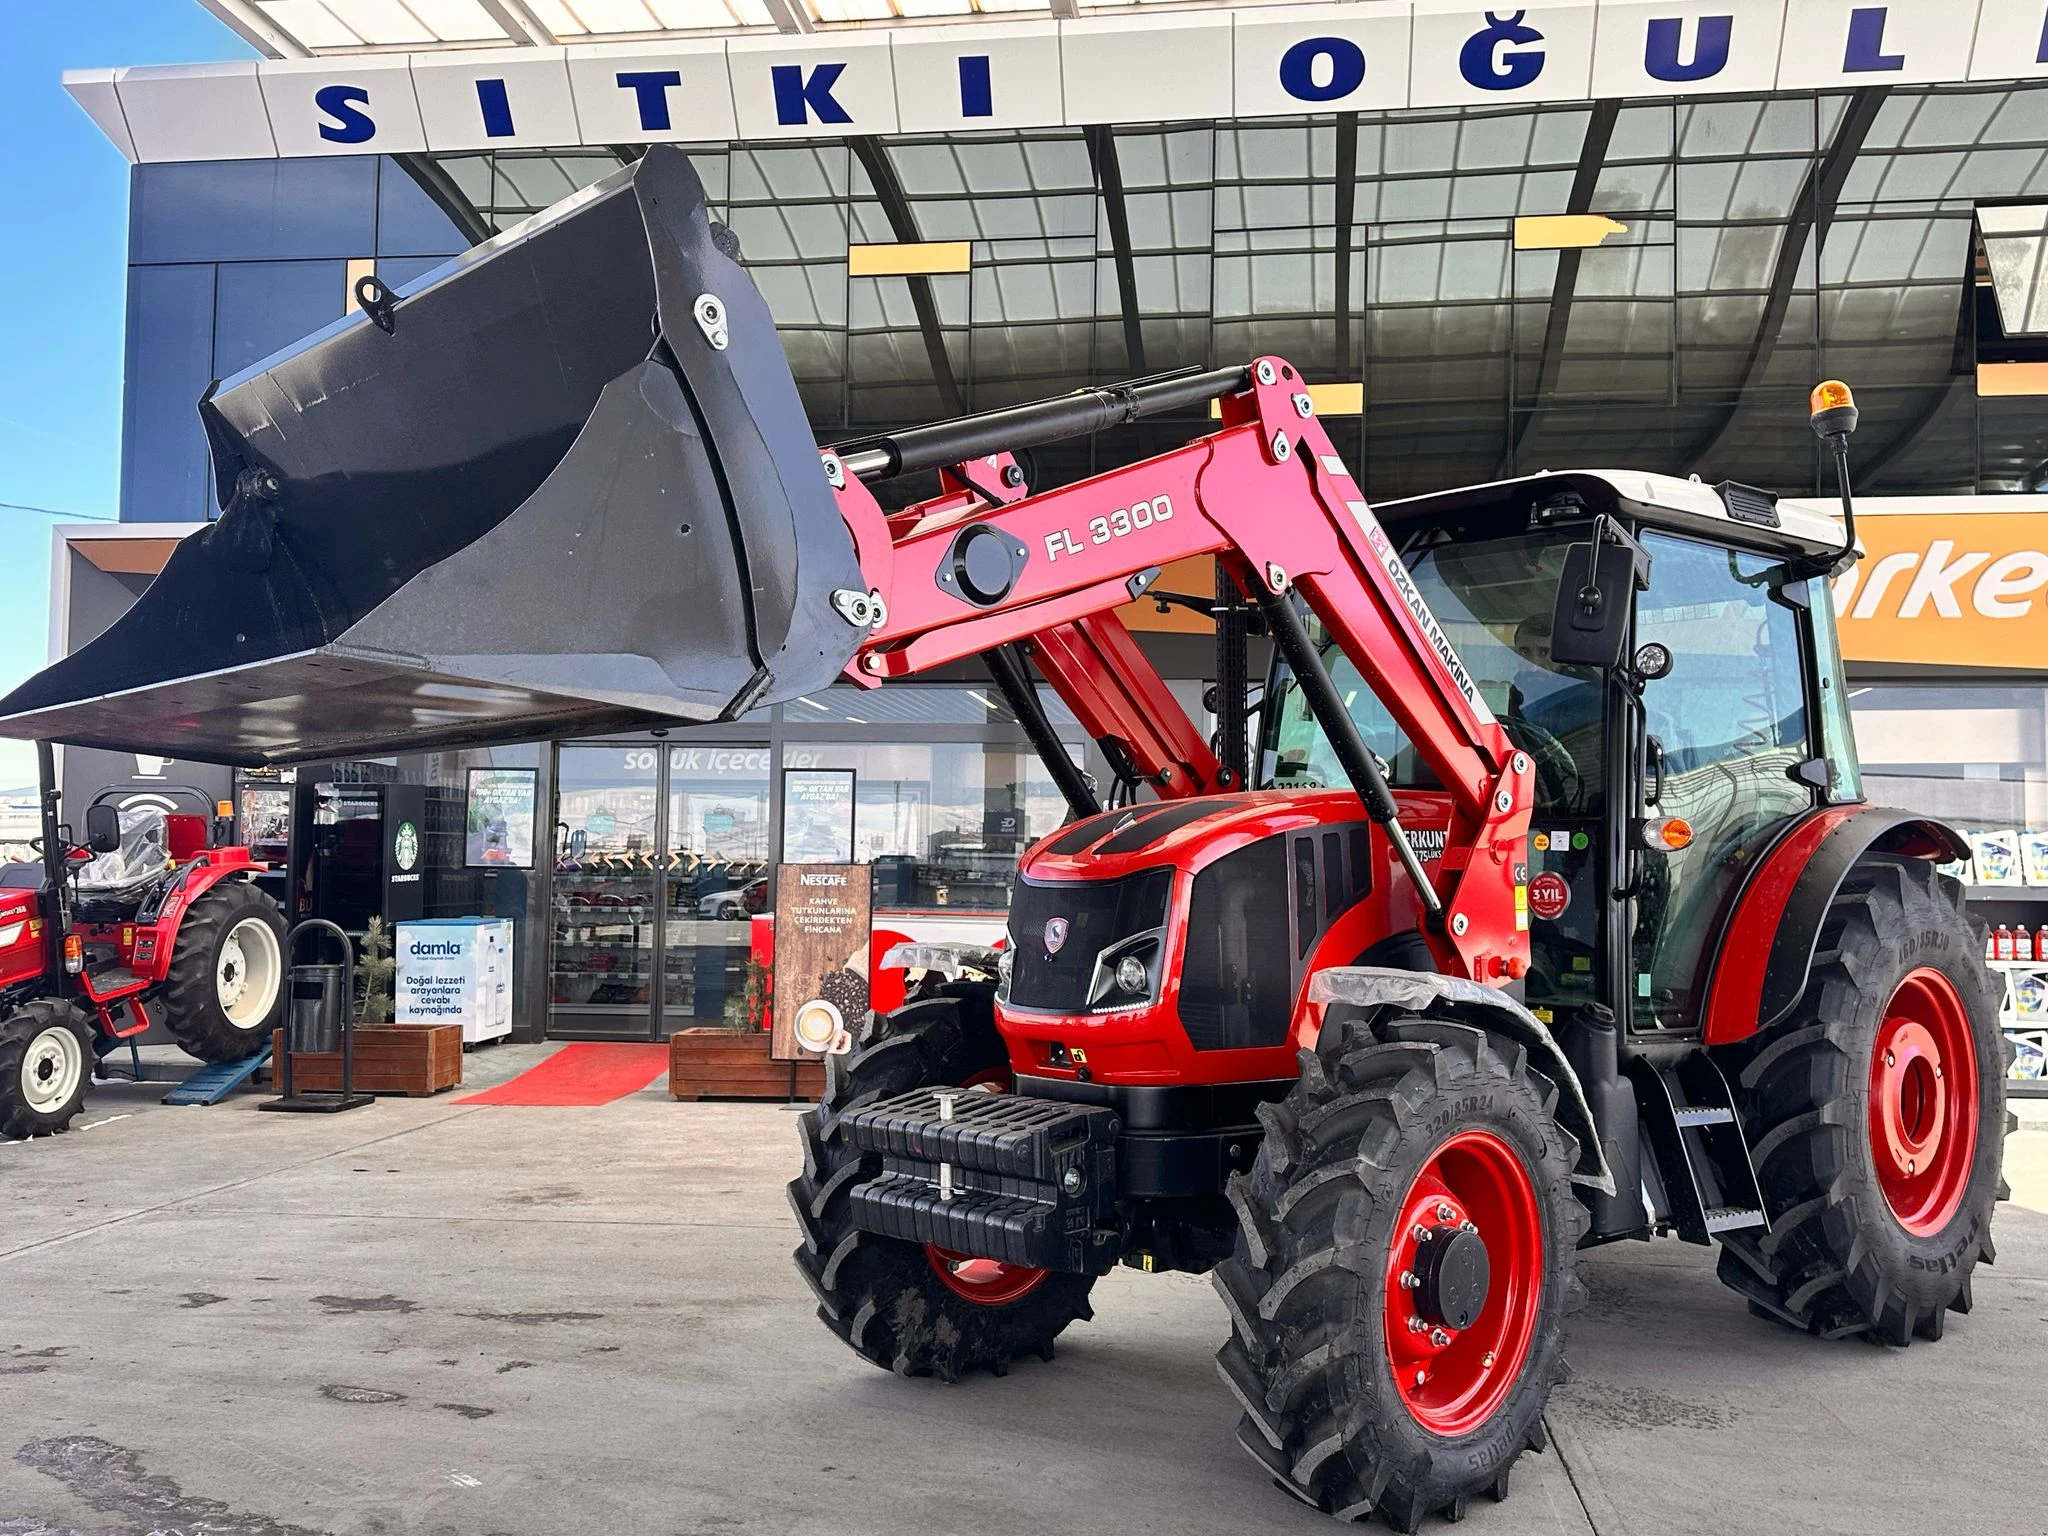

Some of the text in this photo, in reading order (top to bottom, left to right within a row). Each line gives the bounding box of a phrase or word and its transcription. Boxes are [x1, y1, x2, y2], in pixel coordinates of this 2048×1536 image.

[316, 10, 2048, 144] SITKI OĞUL
[1044, 494, 1174, 562] FL 3300
[1832, 540, 2048, 619] rke
[1388, 558, 1474, 703] ÖZKAN MAKİNA
[623, 748, 701, 770] souk
[391, 873, 420, 883] STARBUCKS
[800, 871, 848, 886] NESCAFÉ
[1532, 889, 1563, 900] 3 YIL
[791, 907, 857, 915] TUTKUNLARINA
[794, 916, 852, 925] ÇEKİRDEKTEN
[804, 925, 842, 934] FİNCANA
[410, 940, 461, 955] damla
[406, 975, 466, 986] Doğal lezzeti
[410, 986, 461, 996] arayanlara
[420, 995, 450, 1004] cevabı
[409, 1005, 462, 1016] kaynağında
[1425, 1095, 1494, 1139] 320/85R24
